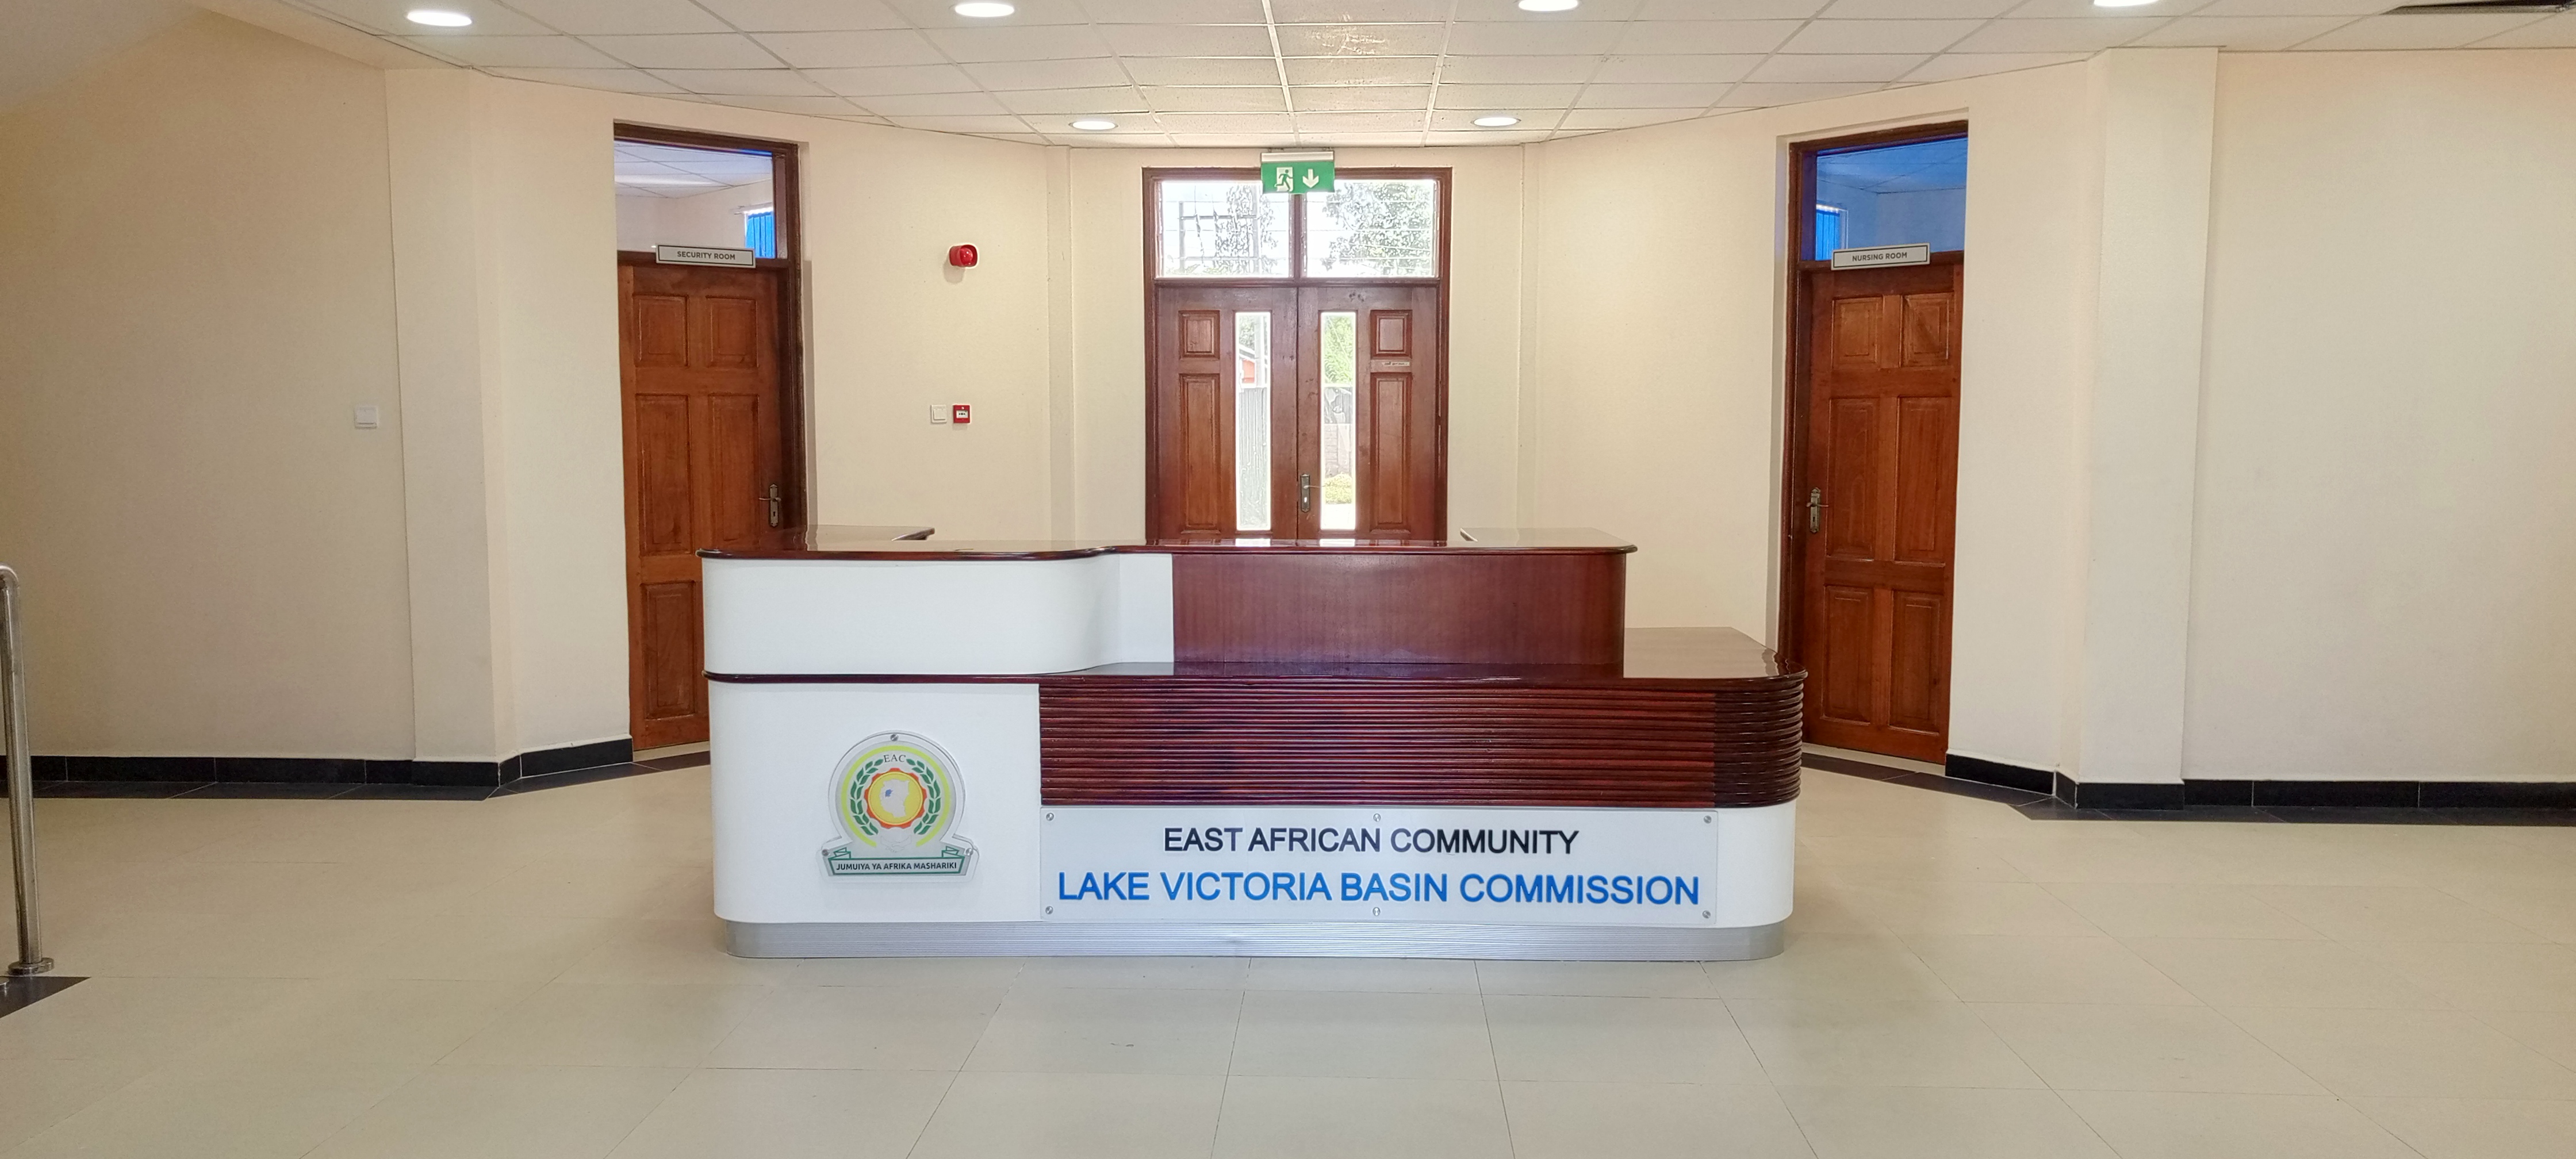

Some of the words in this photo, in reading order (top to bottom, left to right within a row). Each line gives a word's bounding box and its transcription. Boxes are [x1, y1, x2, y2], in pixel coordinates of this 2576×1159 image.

[677, 251, 712, 259] SECURITY
[1851, 254, 1884, 262] NURSING
[883, 754, 907, 763] EAC
[1164, 827, 1243, 851] EAST
[1248, 827, 1381, 852] AFRICAN
[1390, 828, 1580, 854] COMMUNITY
[835, 862, 871, 870] JUMUIYA
[1059, 872, 1150, 901] LAKE
[1159, 872, 1333, 901] VICTORIA
[1341, 872, 1447, 902] BASIN
[1459, 873, 1700, 905] COMMISSION
